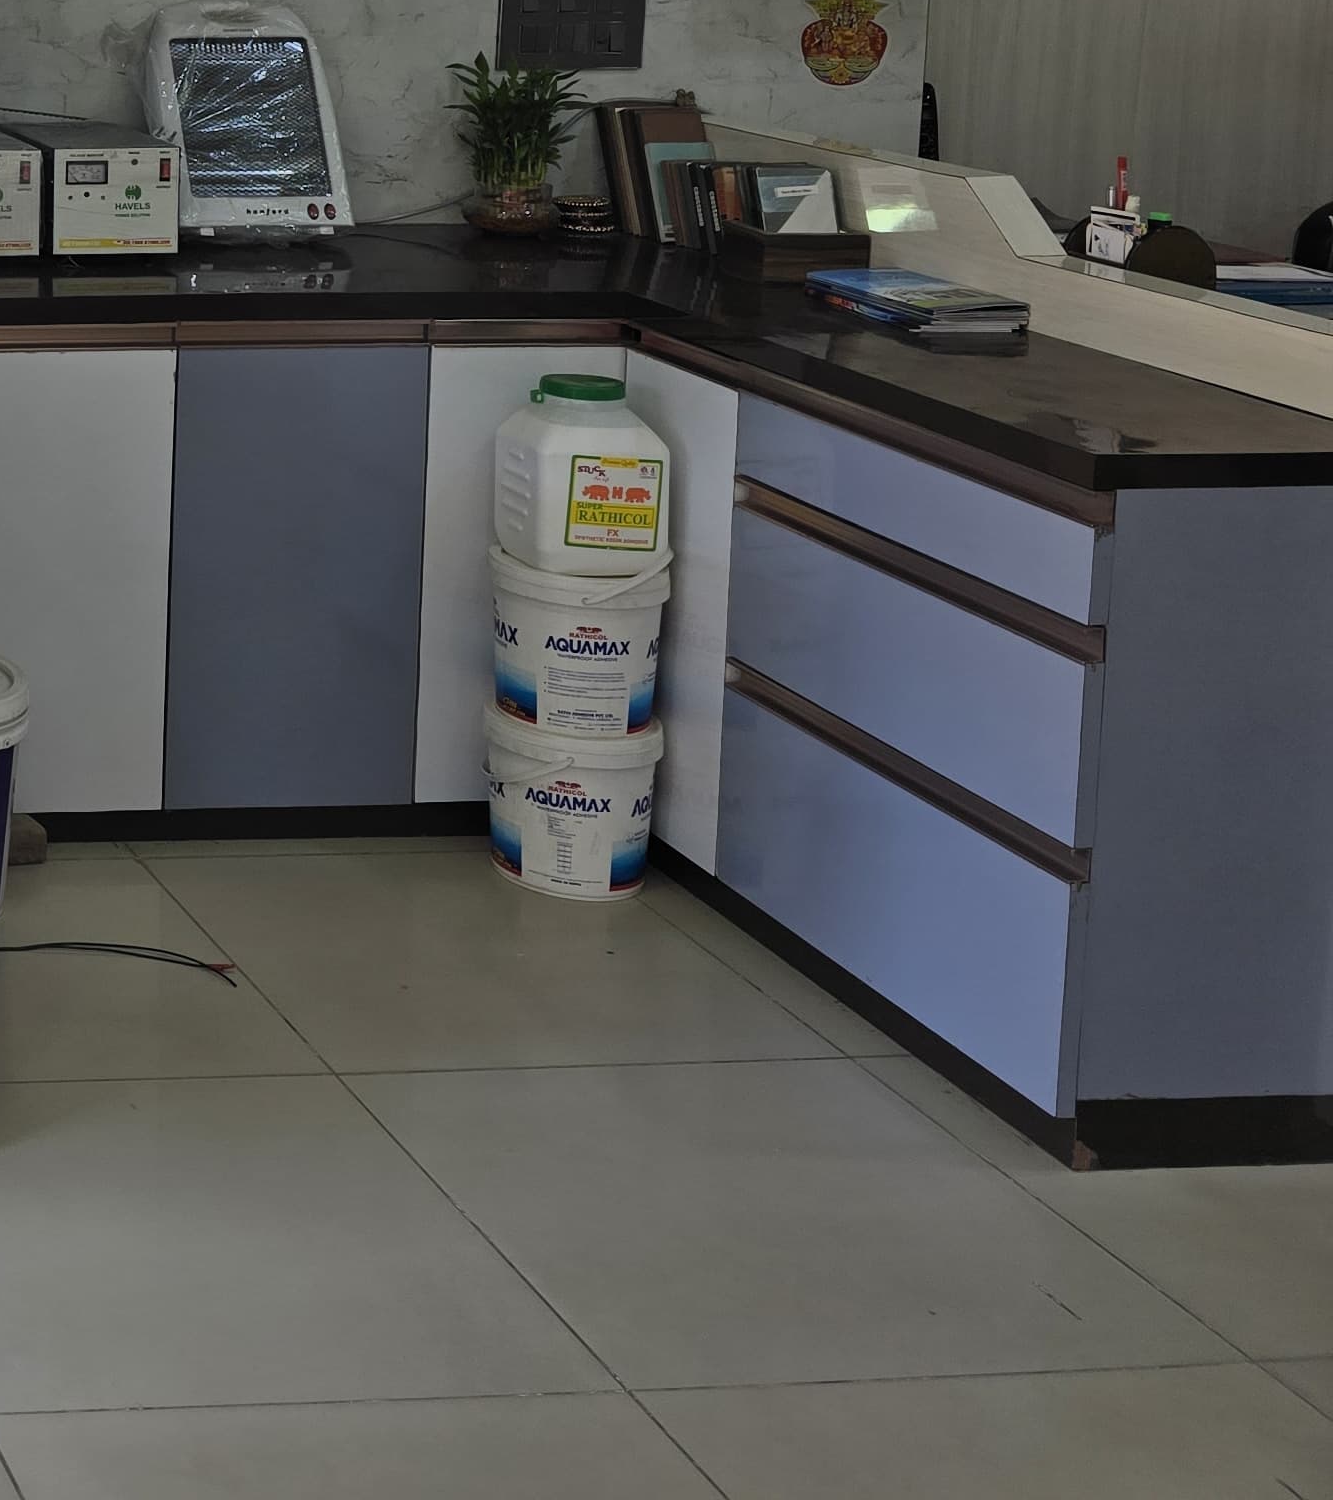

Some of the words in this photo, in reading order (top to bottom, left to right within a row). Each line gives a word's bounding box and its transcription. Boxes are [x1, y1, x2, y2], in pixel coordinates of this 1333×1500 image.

[114, 202, 151, 211] HAVELS
[579, 510, 651, 526] RATHICOL
[569, 632, 608, 641] RATHICOL
[544, 635, 631, 656] AQUAMAX
[547, 785, 587, 796] RATHICOL
[525, 787, 612, 813] AQUAMAX
